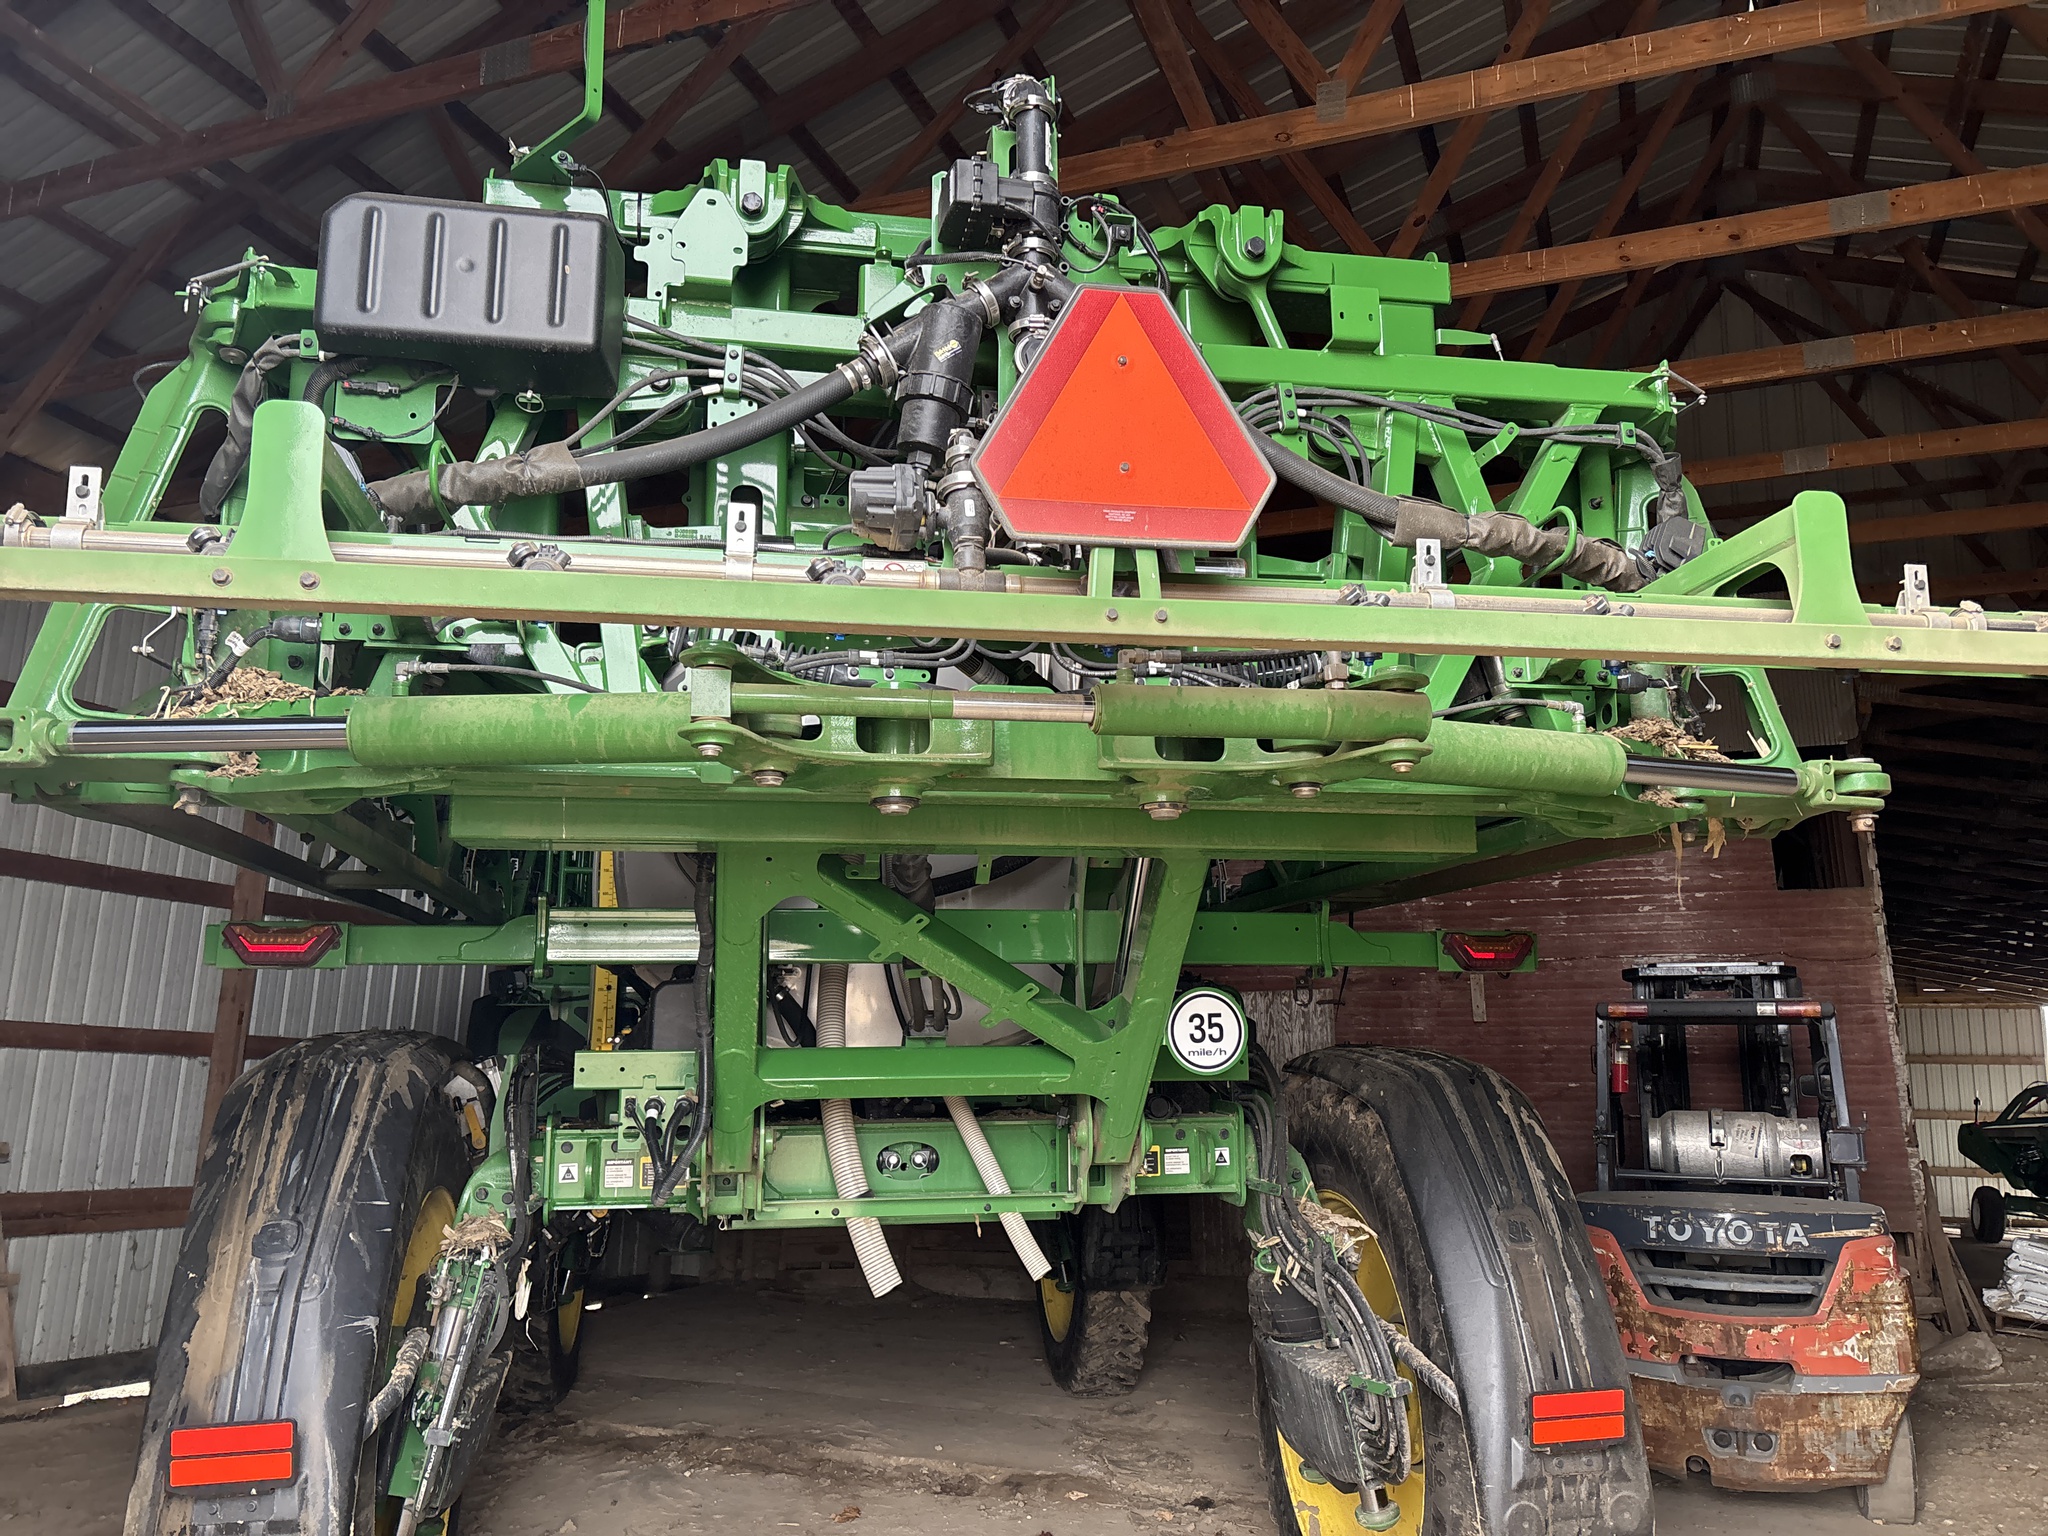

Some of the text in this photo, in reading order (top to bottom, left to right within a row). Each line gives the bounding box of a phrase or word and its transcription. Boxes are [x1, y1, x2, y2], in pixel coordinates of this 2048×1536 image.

[1188, 1012, 1224, 1043] 35
[1188, 1047, 1227, 1057] mile/h
[1642, 1214, 1810, 1247] TOYOTA
